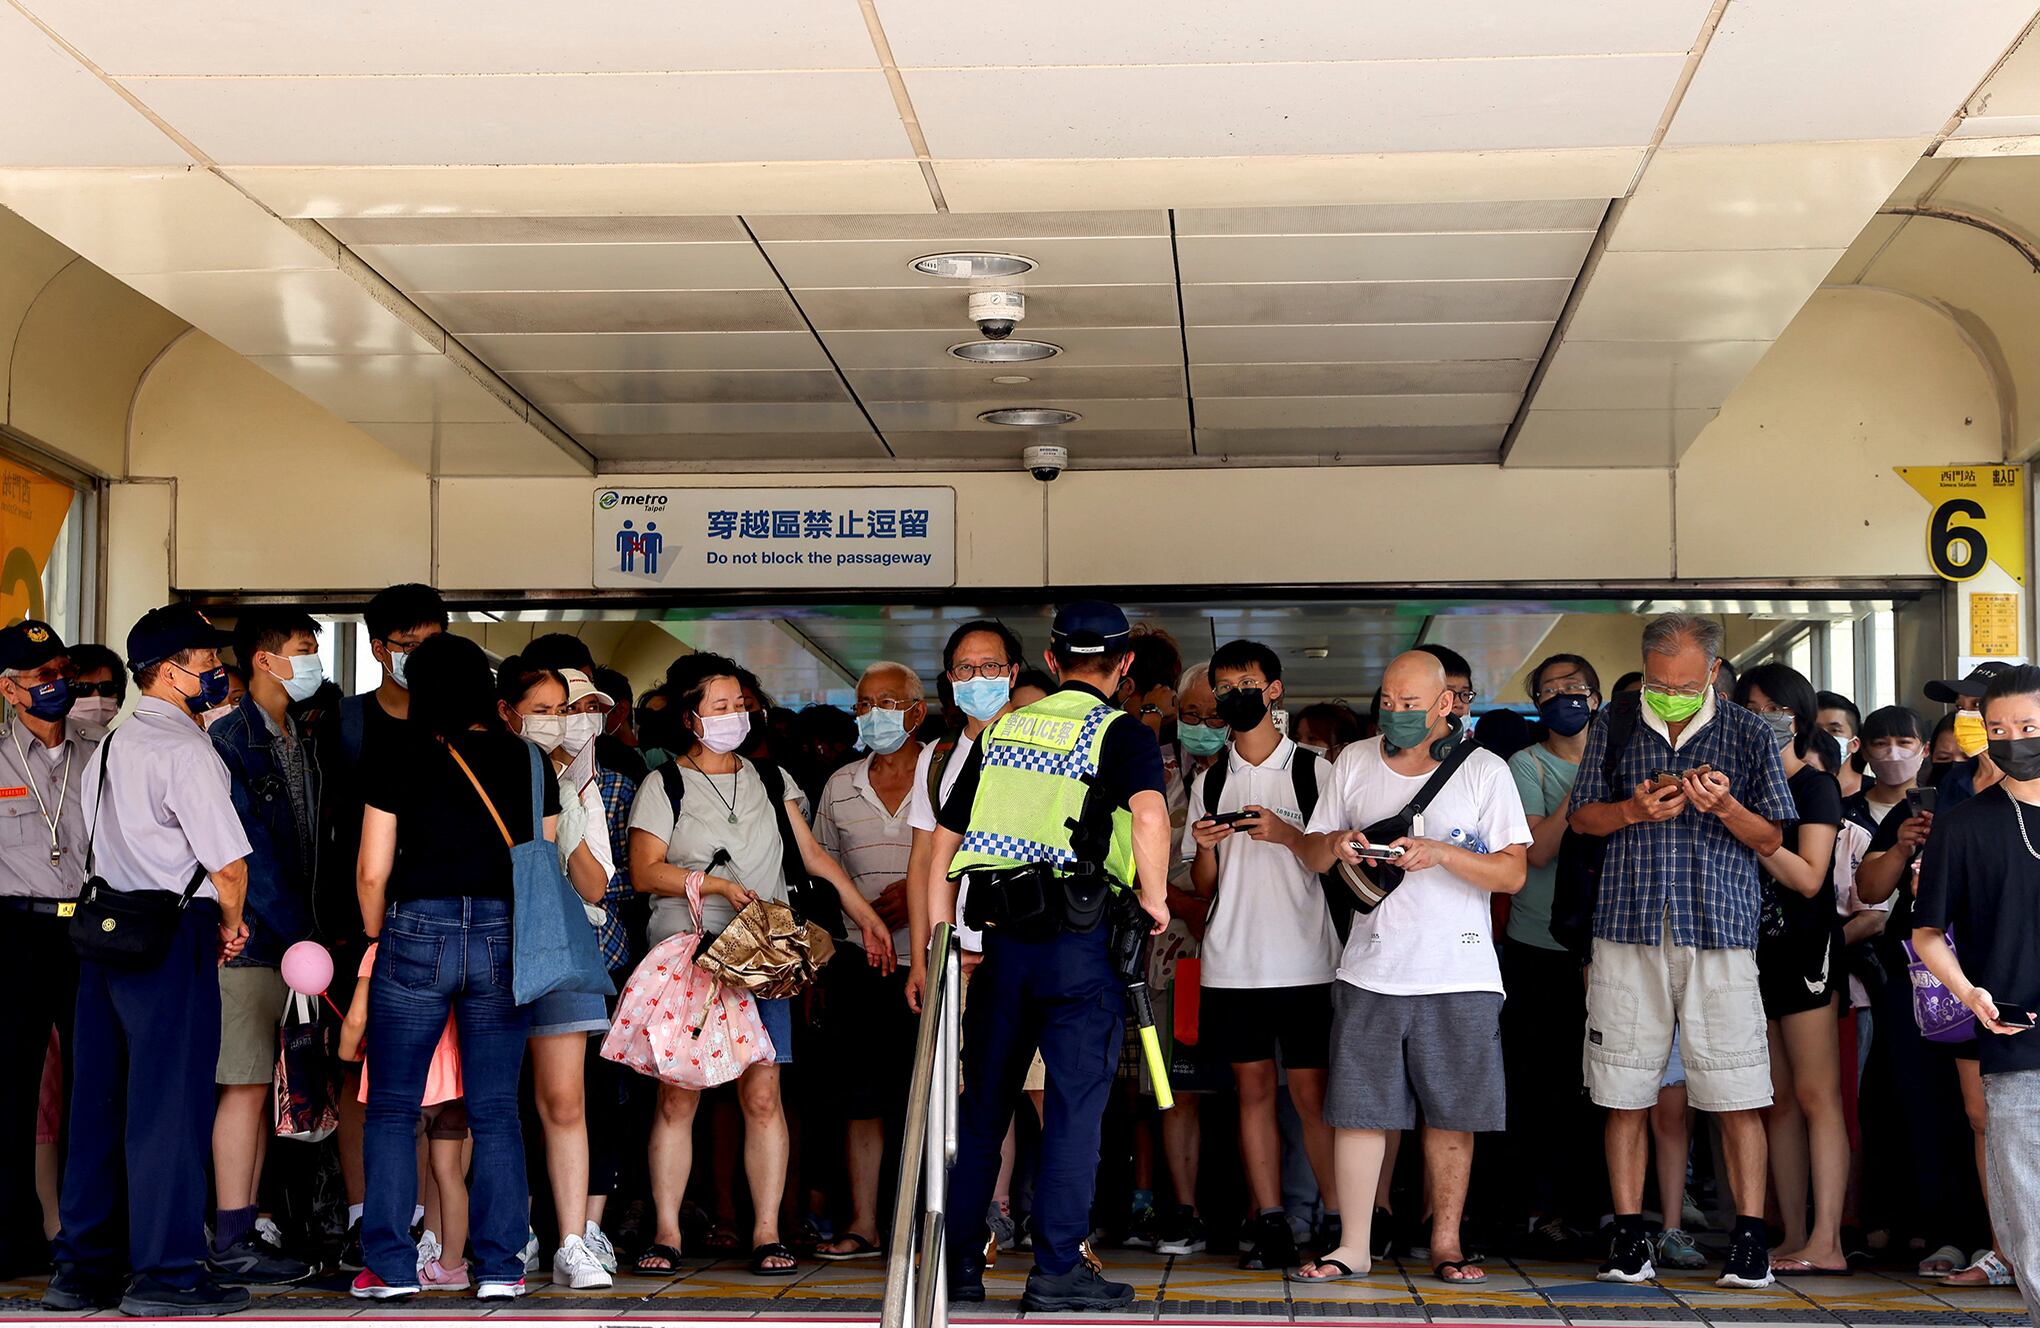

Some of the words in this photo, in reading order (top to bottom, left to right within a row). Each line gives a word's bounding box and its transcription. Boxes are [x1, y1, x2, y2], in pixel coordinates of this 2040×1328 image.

[1941, 470, 1976, 482] 西門站
[1992, 469, 2015, 483] 出入口
[620, 494, 668, 505] metro
[644, 505, 666, 513] Taipei
[707, 509, 929, 539] 穿越區禁止逗留
[1930, 499, 1988, 579] 6
[706, 552, 727, 564] Do
[733, 552, 757, 565] not
[762, 552, 804, 565] block
[808, 552, 833, 565] the
[837, 553, 932, 567] passageway
